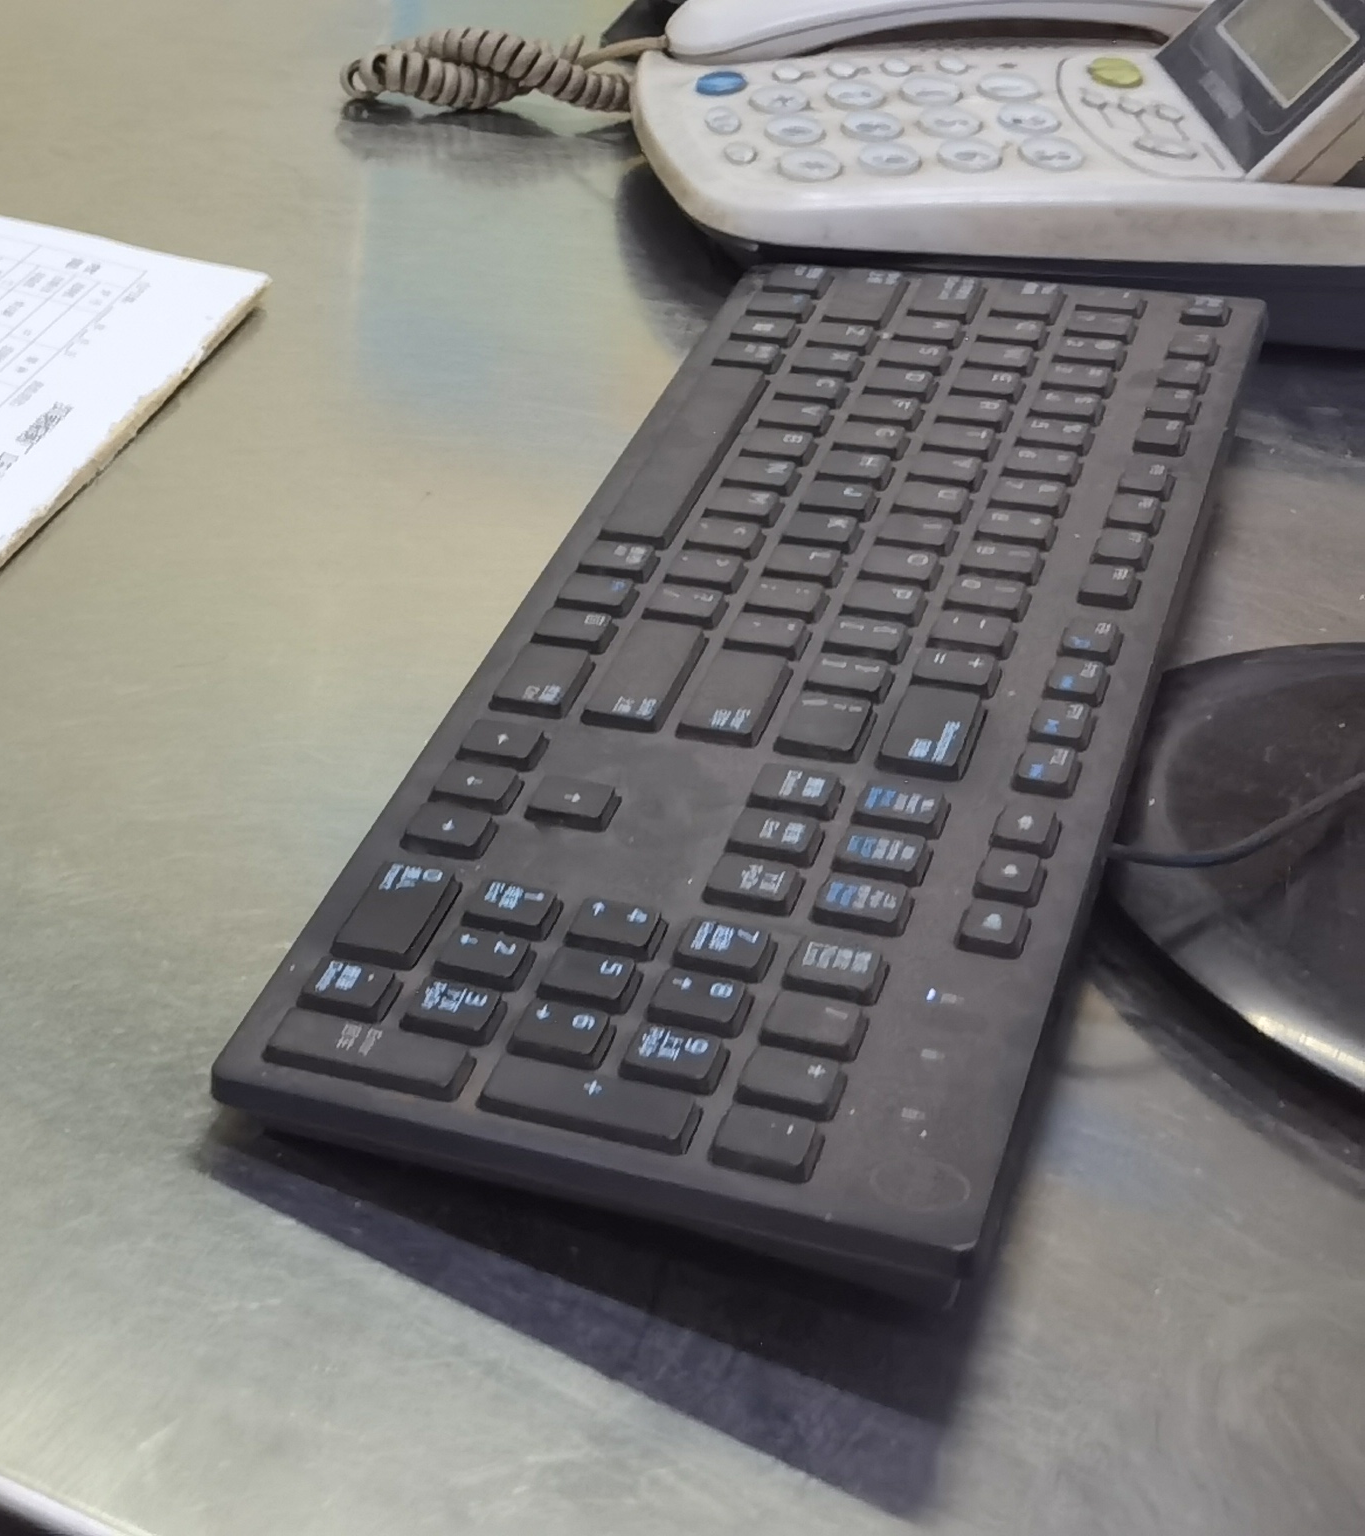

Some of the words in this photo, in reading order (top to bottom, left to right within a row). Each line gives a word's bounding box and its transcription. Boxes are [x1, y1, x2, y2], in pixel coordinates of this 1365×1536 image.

[782, 433, 803, 445] B
[843, 486, 862, 498] J
[907, 553, 929, 567] O
[737, 927, 761, 944] 7
[493, 939, 517, 956] 2
[599, 958, 624, 976] 5
[709, 981, 734, 999] 8
[465, 990, 489, 1008] 3
[571, 1013, 596, 1031] 6
[684, 1037, 709, 1055] 9
